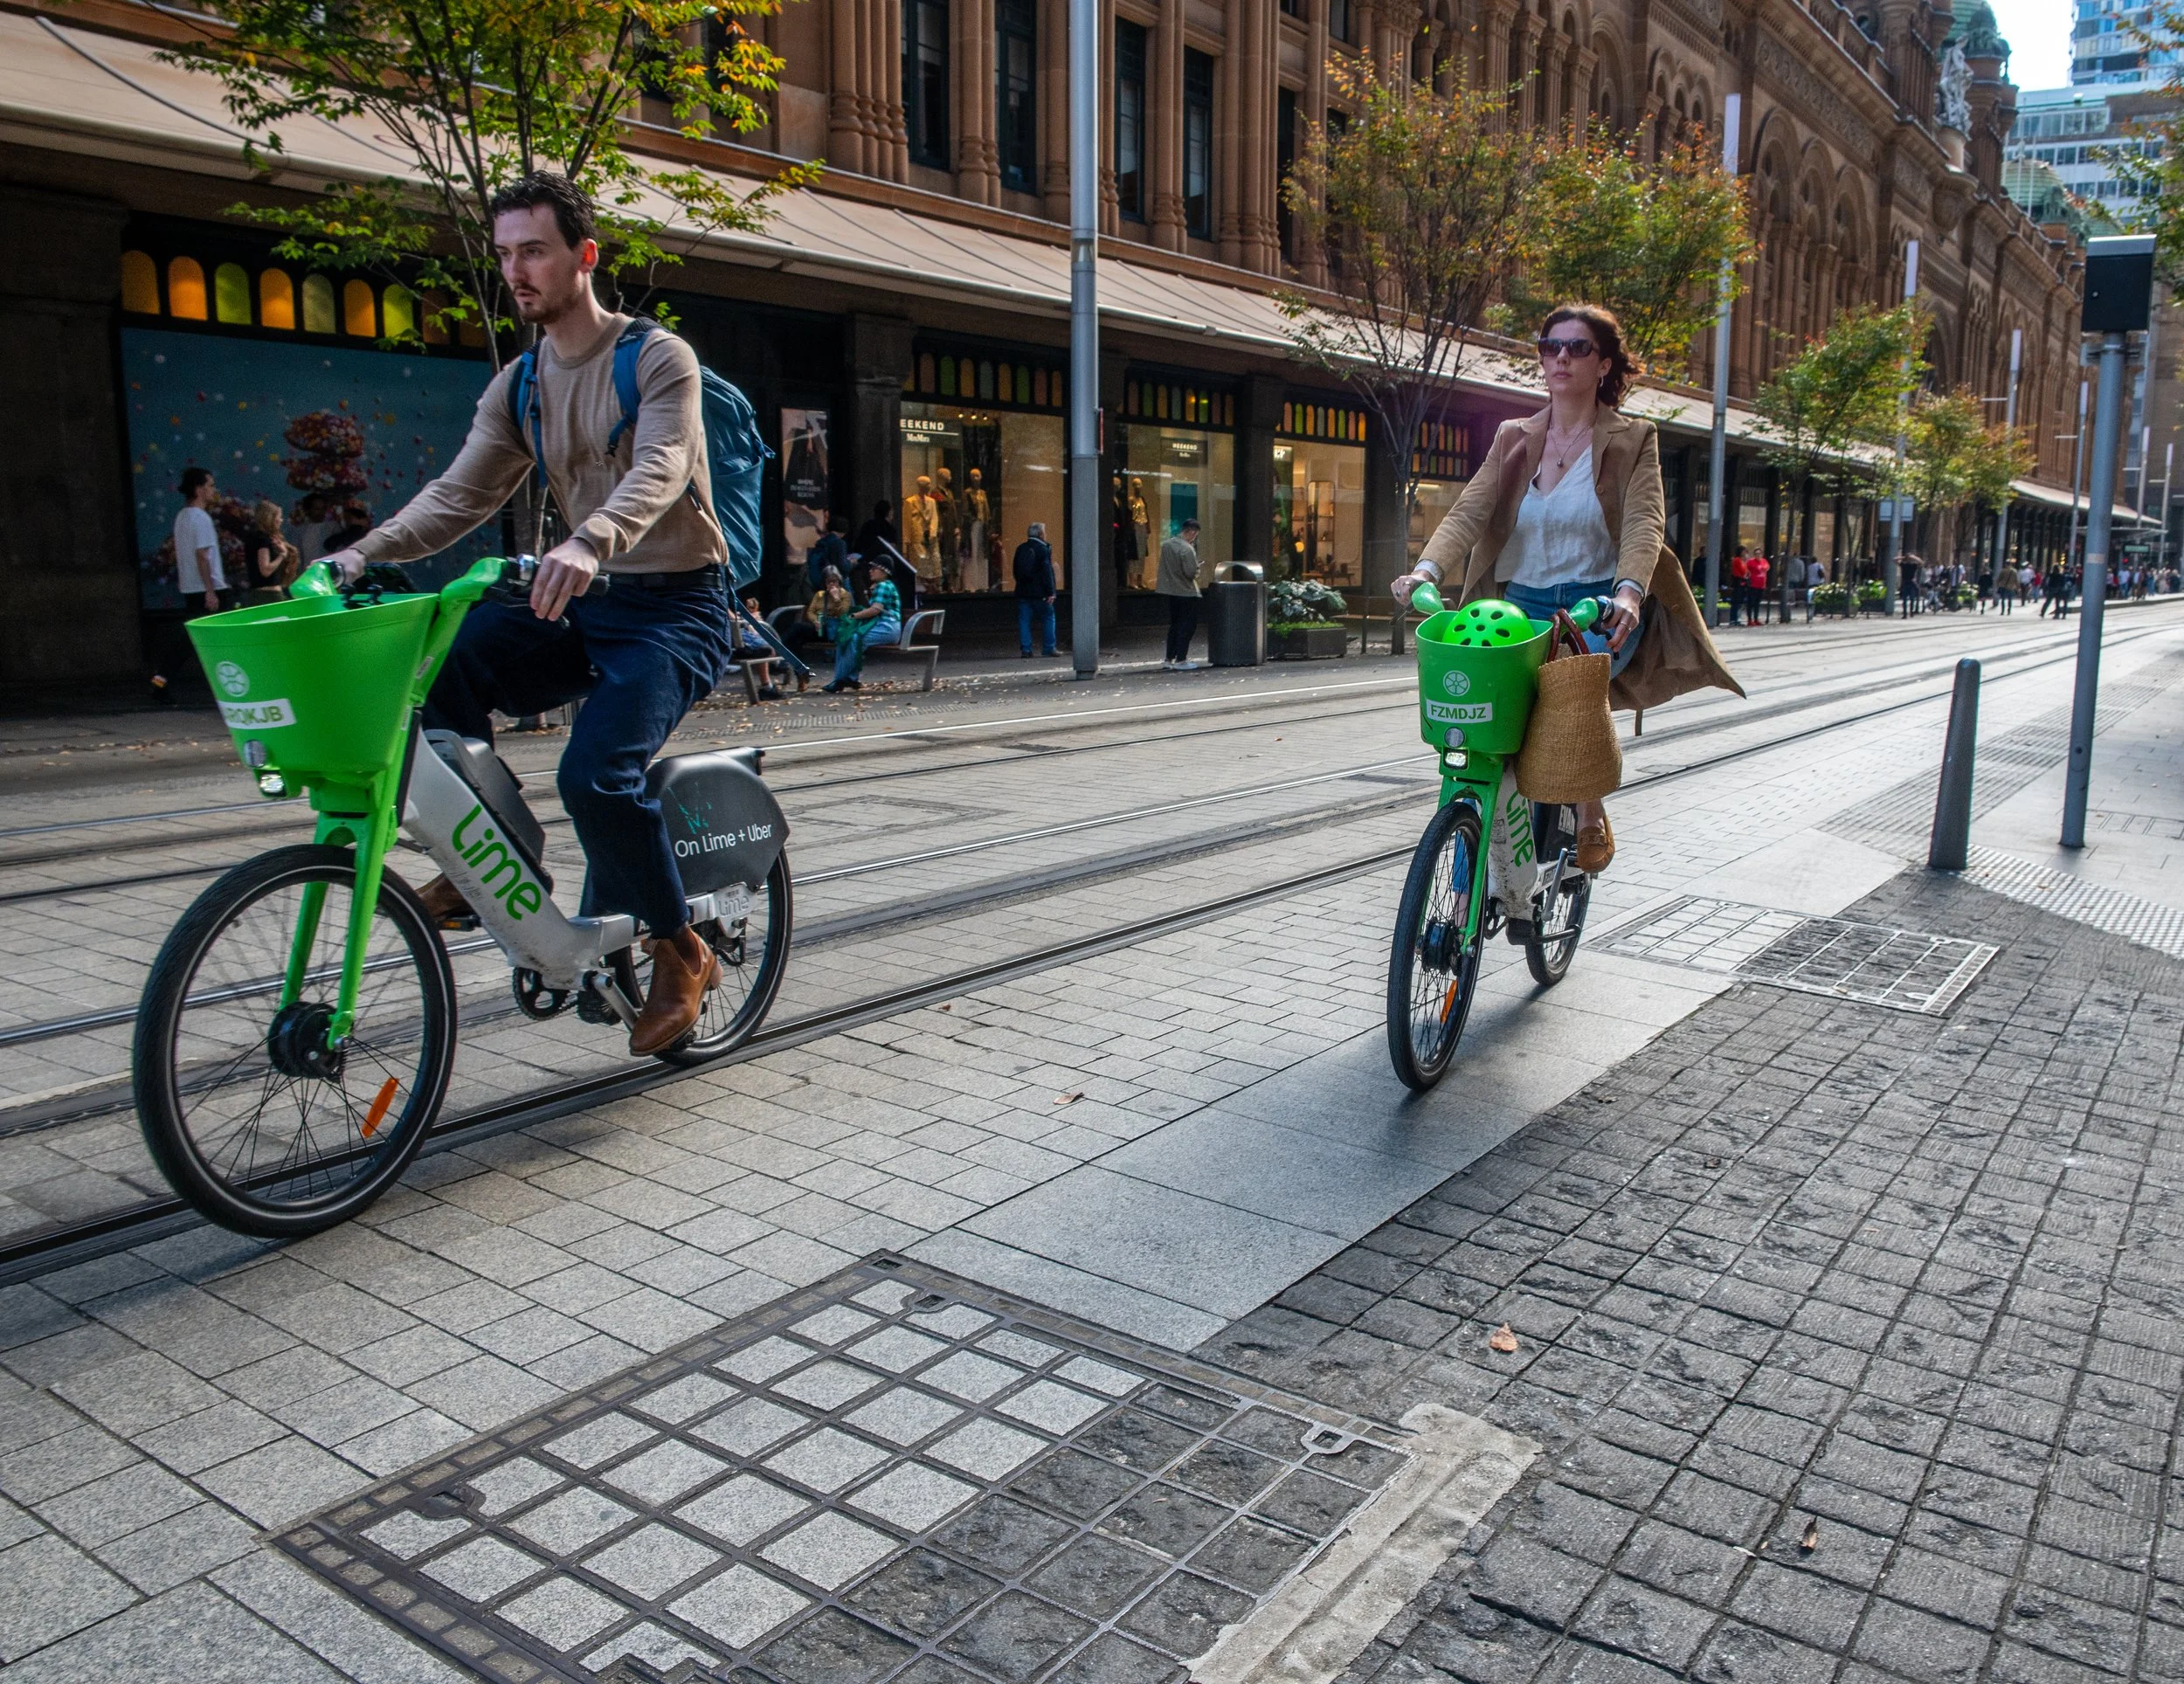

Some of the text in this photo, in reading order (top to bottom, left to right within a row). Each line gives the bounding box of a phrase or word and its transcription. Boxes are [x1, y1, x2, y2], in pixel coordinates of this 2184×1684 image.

[900, 419, 944, 431] EEKEND
[1430, 704, 1487, 720] FZMDJZ
[674, 824, 772, 858] On Lime + Uber
